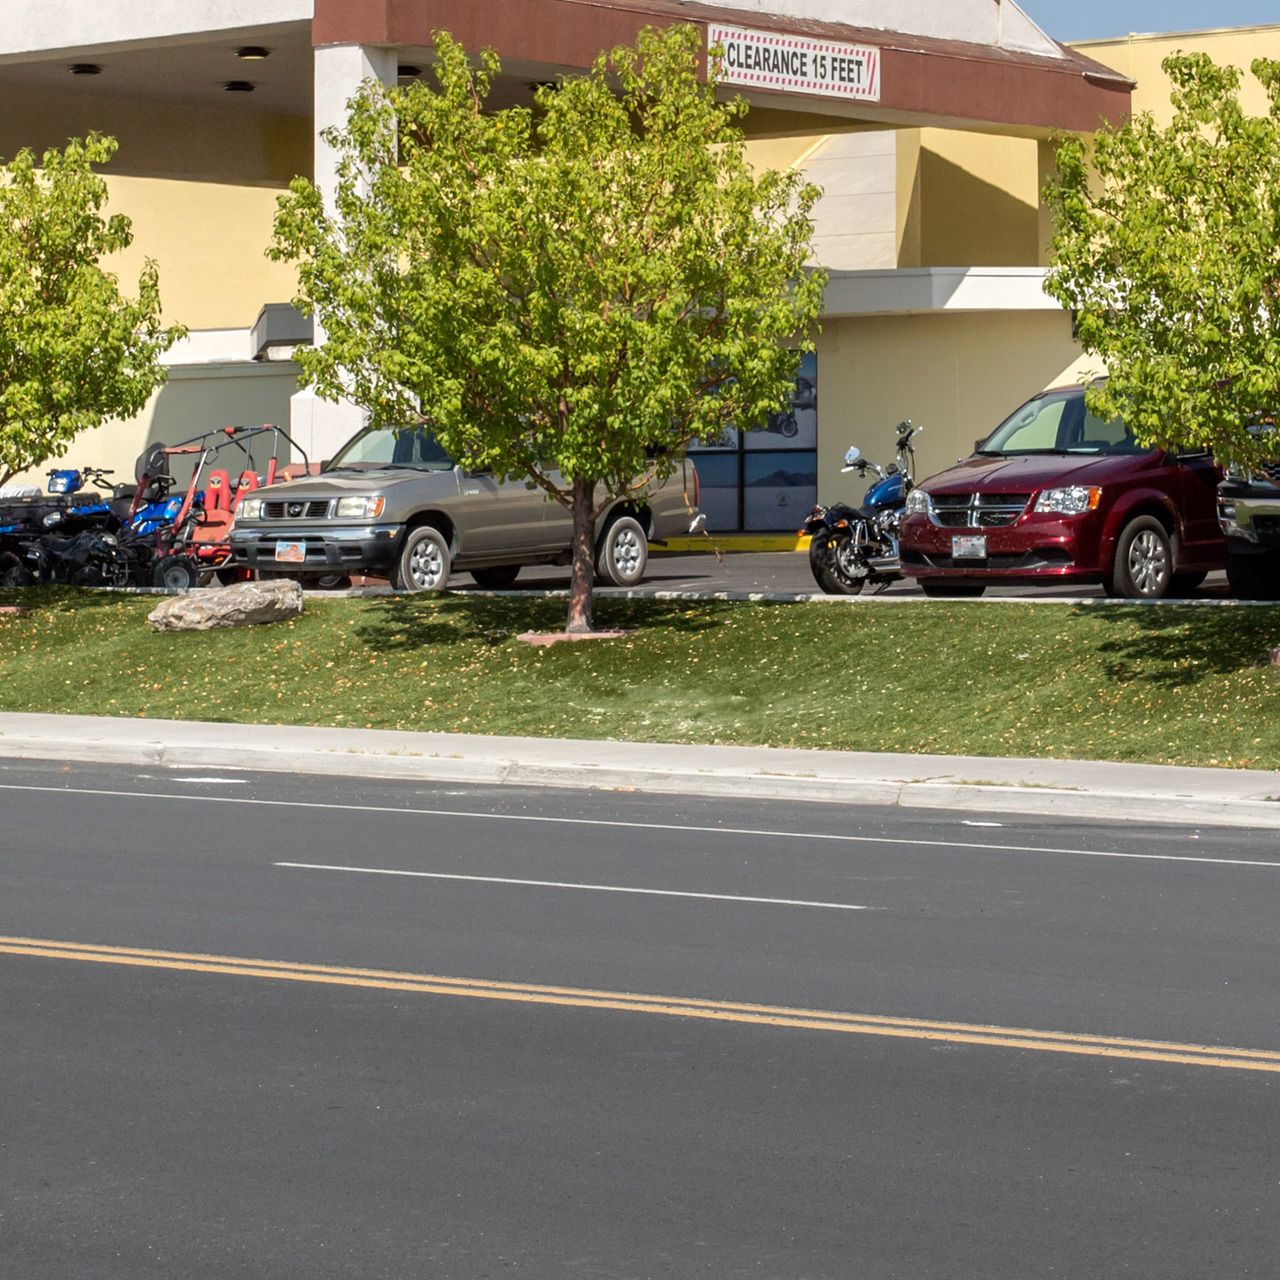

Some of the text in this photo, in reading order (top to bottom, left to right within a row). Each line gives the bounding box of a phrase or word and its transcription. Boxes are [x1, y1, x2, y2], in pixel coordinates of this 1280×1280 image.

[727, 41, 863, 84] CLEARANCE 15 FEET
